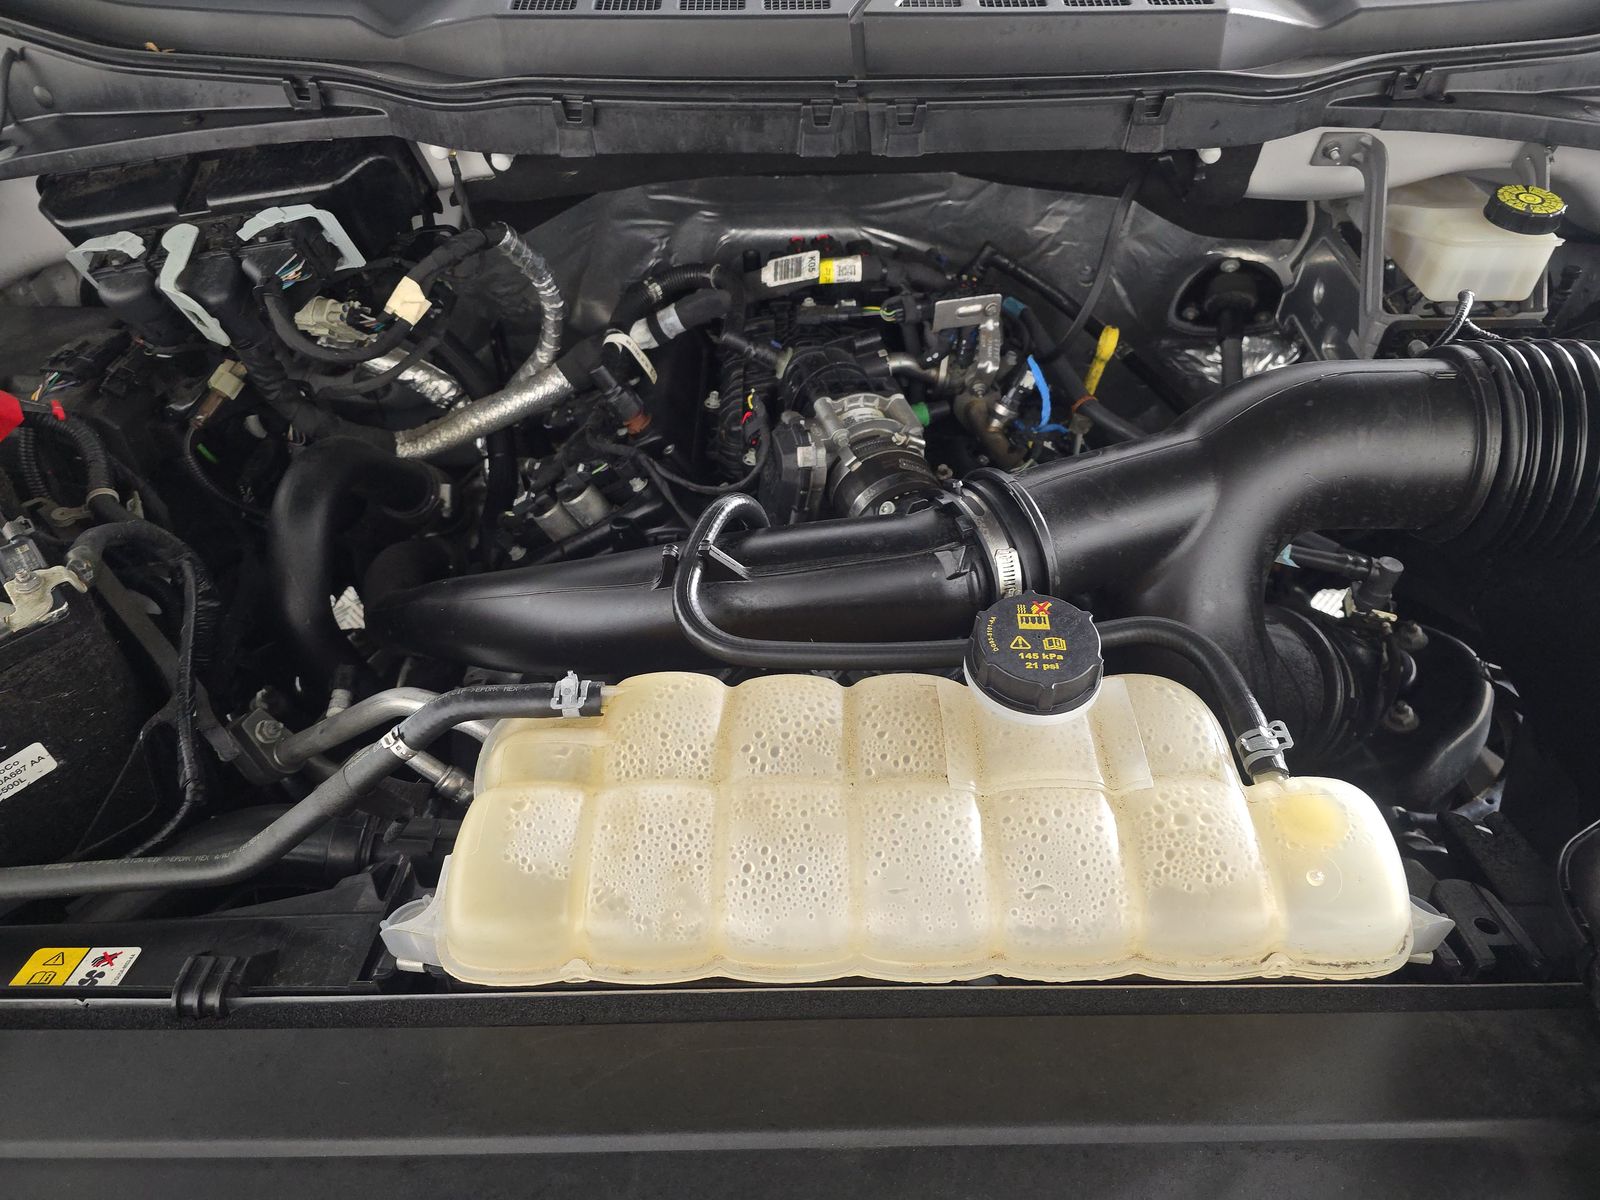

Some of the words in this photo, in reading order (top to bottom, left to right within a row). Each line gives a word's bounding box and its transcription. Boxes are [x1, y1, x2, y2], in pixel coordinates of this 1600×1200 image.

[807, 255, 816, 273] K05
[1018, 652, 1039, 660] 145
[1042, 652, 1064, 660] kPa
[1025, 661, 1039, 669] 21
[1042, 662, 1060, 671] psi
